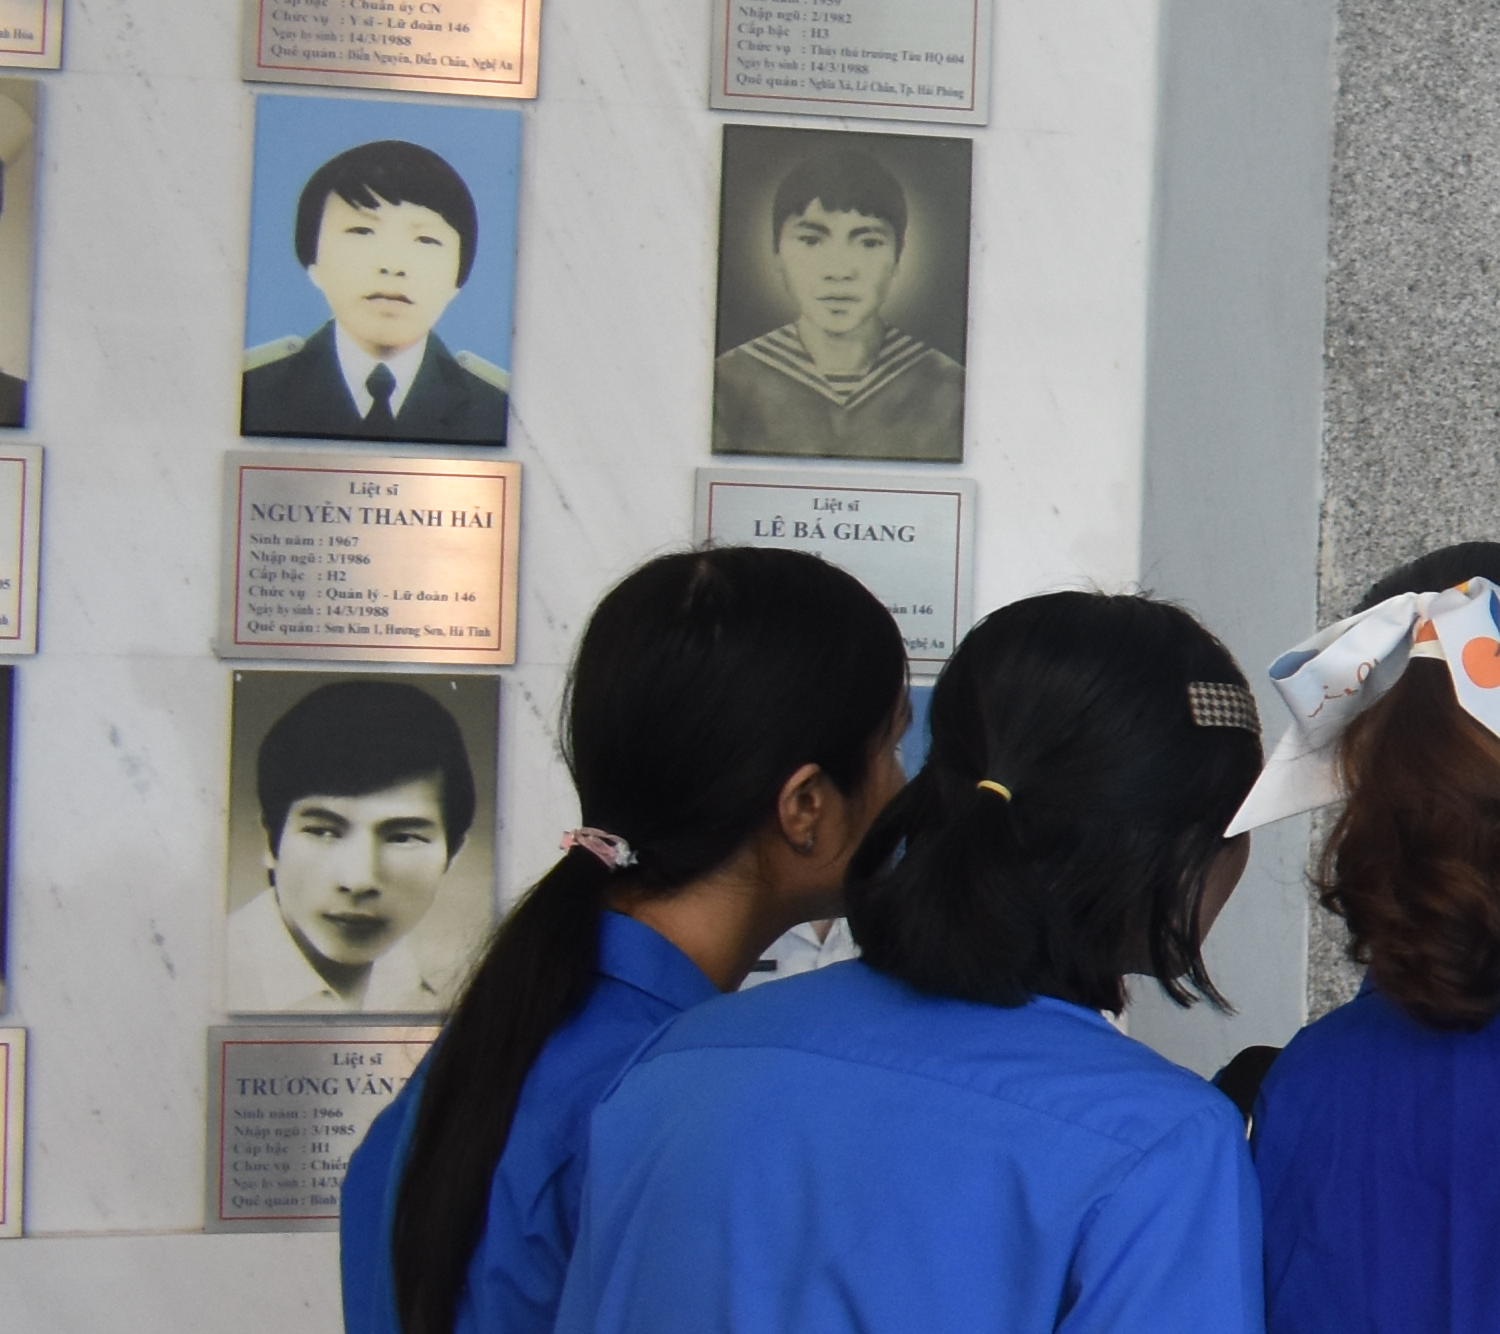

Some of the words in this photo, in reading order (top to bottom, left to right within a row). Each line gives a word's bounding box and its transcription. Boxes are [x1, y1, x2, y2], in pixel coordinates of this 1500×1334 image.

[350, 32, 412, 46] 14/3/1988
[349, 482, 380, 498] Liệt
[386, 484, 399, 496] sĩ
[813, 497, 843, 514] Liệt
[847, 500, 860, 512] sĩ
[250, 501, 352, 525] NGUYỄN
[359, 506, 443, 527] THANH
[450, 506, 494, 529] HẢI
[754, 515, 785, 538] LÊ
[793, 517, 825, 539] BÁ
[833, 522, 916, 543] GIANG
[328, 536, 359, 547] 1967
[327, 570, 346, 582] H2
[326, 605, 390, 617] 14/3/1988
[912, 604, 933, 615] 146
[333, 1053, 364, 1069] Liệt
[369, 1052, 383, 1065] sĩ
[237, 1075, 338, 1096] TRƯƠNG
[346, 1074, 394, 1096] VĂN
[312, 1108, 343, 1119] 1966
